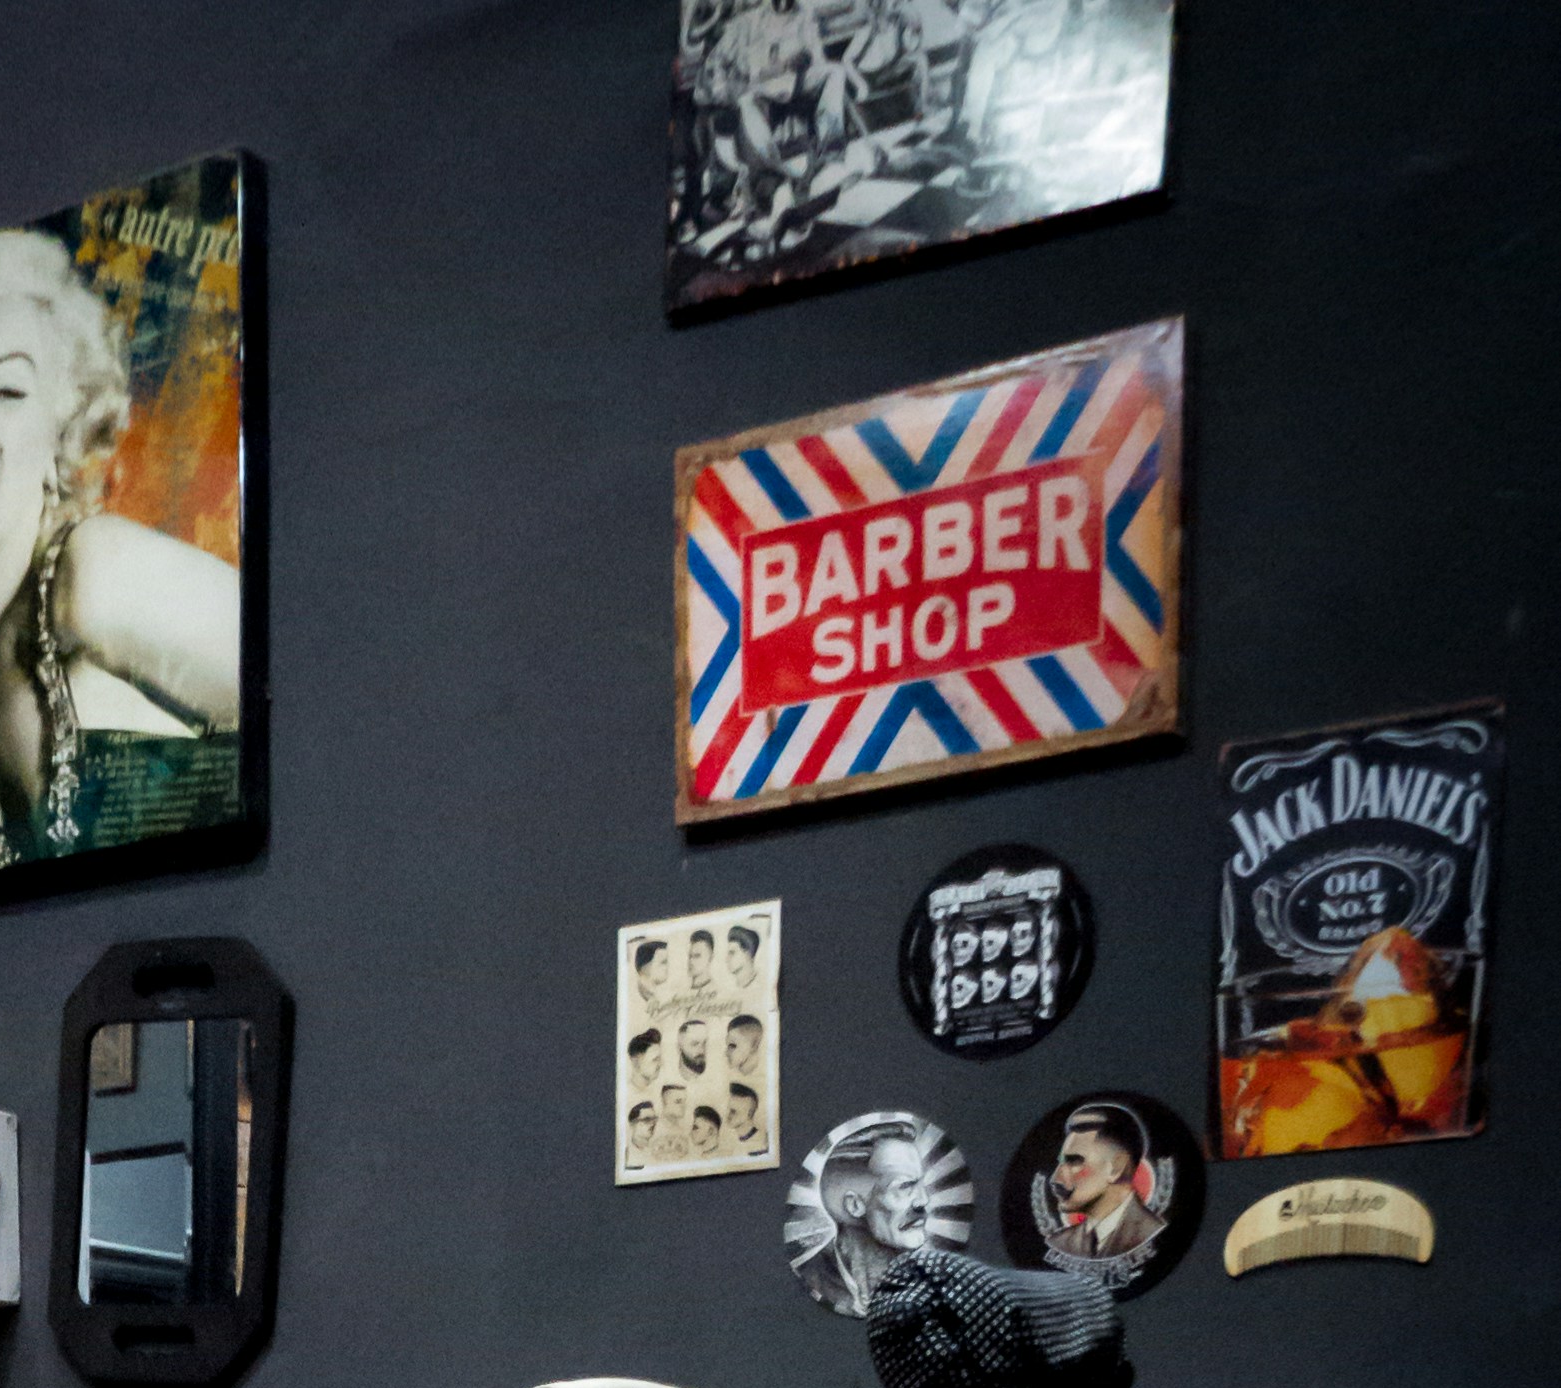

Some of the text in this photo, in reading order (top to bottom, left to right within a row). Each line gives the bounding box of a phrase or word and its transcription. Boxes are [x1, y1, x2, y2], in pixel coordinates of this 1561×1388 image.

[749, 472, 1094, 640] BARBER
[810, 582, 1016, 684] SHOP
[1229, 754, 1488, 878] JACK DANIEL'S
[1323, 867, 1381, 896] Old
